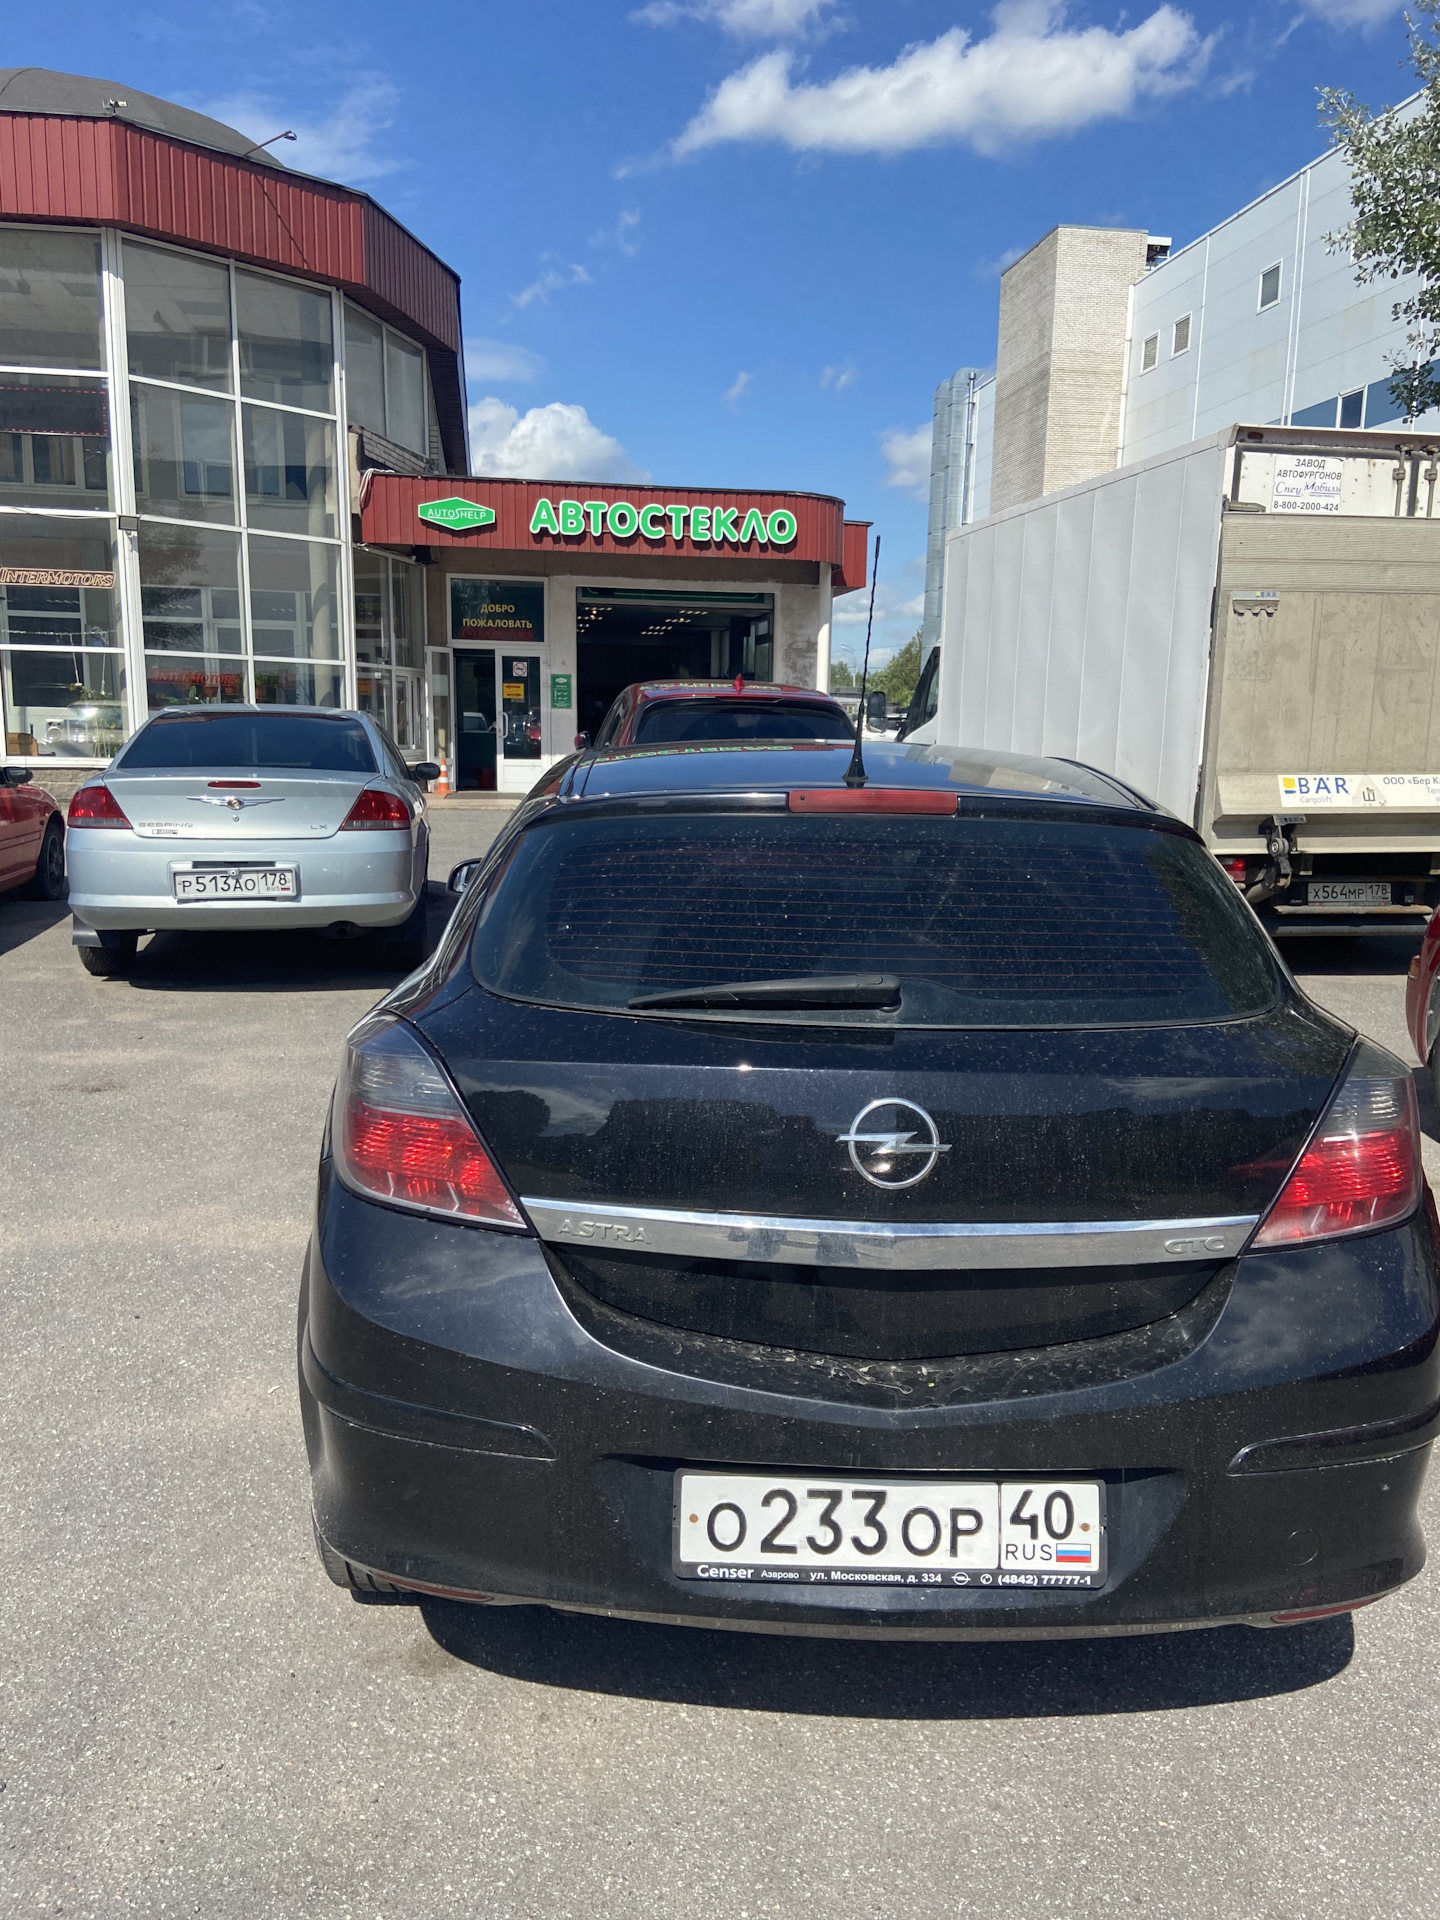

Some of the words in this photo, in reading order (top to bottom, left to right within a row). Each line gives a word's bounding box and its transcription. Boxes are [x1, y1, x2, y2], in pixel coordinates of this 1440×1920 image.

[1295, 459, 1326, 470] ЗАВОД
[1277, 470, 1342, 480] АВТОФУРГОНОВ
[1273, 500, 1339, 511] 8-800-2000-424
[529, 498, 798, 545] АВТОСТЕКЛО
[480, 603, 515, 613] ДОБРО
[462, 618, 533, 629] ПОЖАЛОВАТЬ
[1383, 776, 1405, 785] ООО
[1300, 795, 1333, 805] Cargolift
[261, 872, 288, 886] 178
[1313, 885, 1364, 900] Х564МР
[1368, 884, 1388, 896] 178
[557, 1219, 653, 1245] ASTRA
[1164, 1235, 1225, 1255] GTC
[706, 1488, 984, 1558] О233ОР
[1009, 1489, 1076, 1541] 40
[1005, 1543, 1053, 1561] RUS
[697, 1564, 754, 1579] Genser
[760, 1570, 800, 1580] Азарово
[810, 1571, 827, 1581] ул.
[830, 1571, 904, 1583] Московская,
[906, 1574, 919, 1583] д.
[921, 1573, 942, 1583] 334
[997, 1574, 1039, 1586] (4842)
[1041, 1575, 1091, 1585] 77777-1
